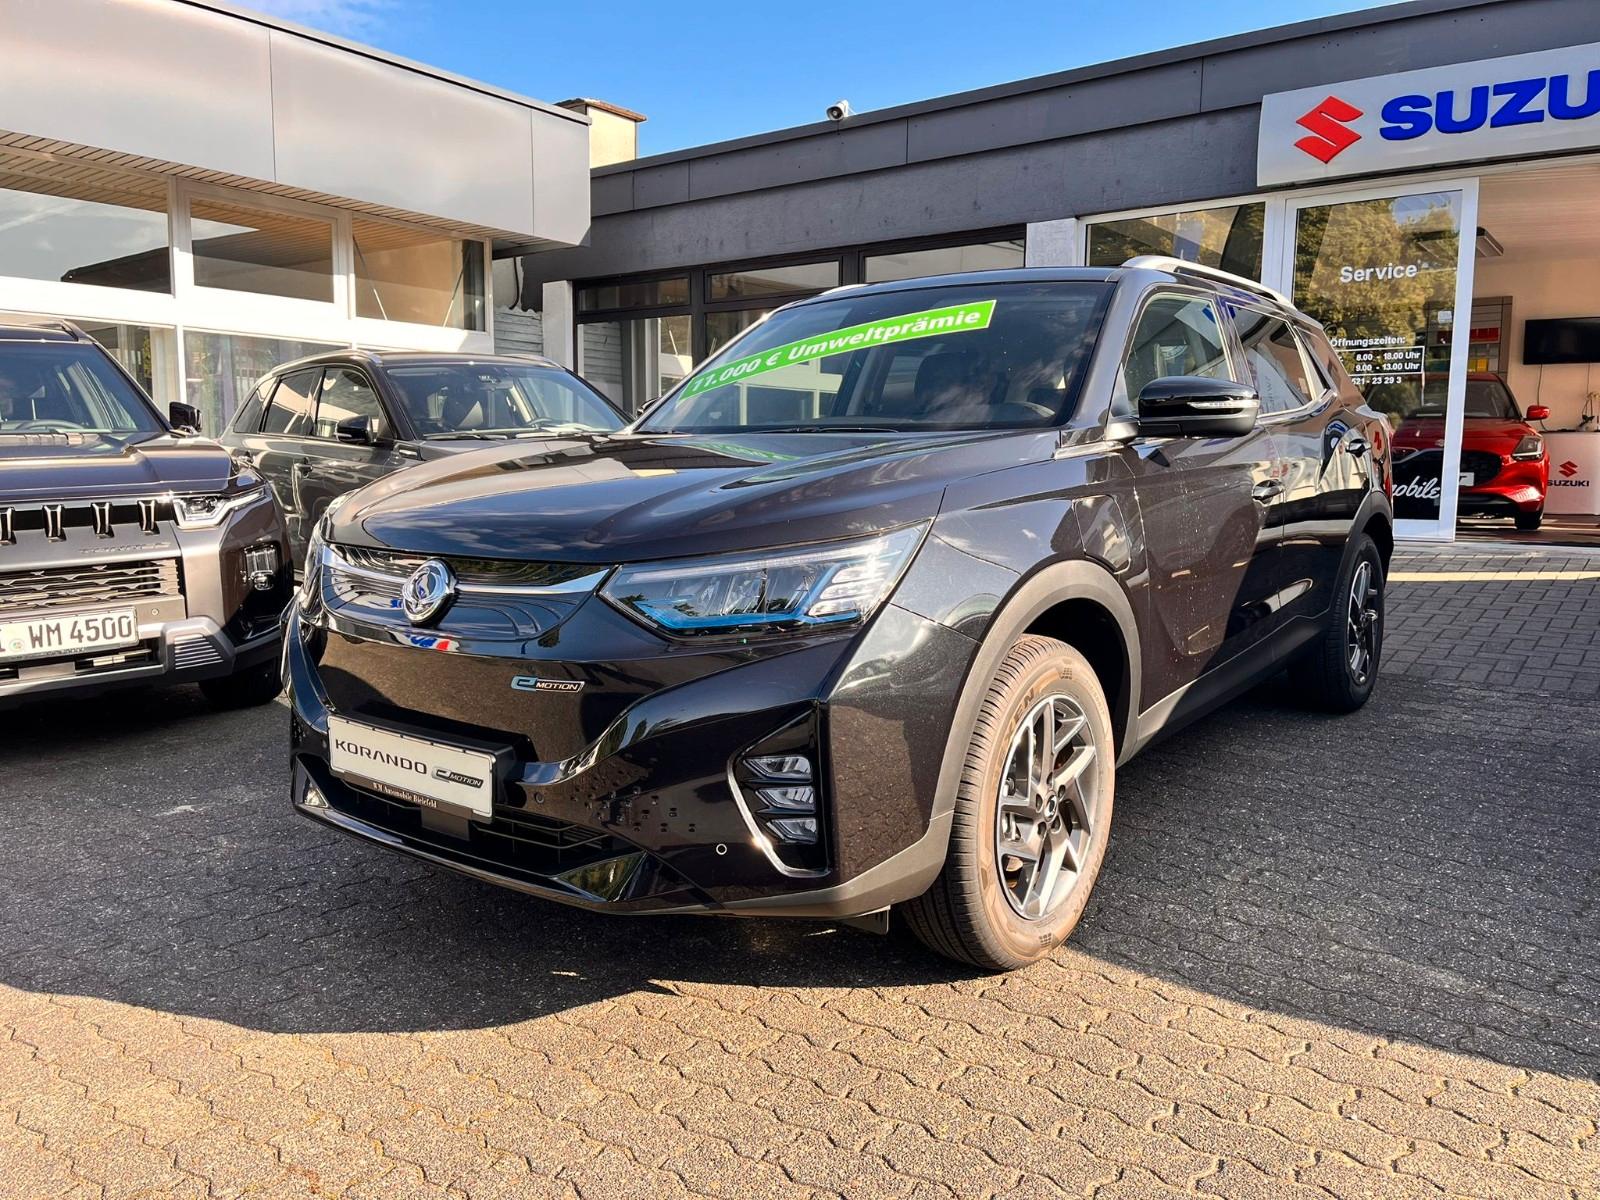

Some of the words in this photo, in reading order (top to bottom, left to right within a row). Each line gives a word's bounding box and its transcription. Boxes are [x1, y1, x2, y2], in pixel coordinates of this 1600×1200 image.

[1379, 69, 1600, 142] SUZU
[1340, 262, 1418, 283] Service
[765, 351, 782, 367] €
[788, 310, 981, 361] Umweltprämie
[1330, 336, 1406, 347] Öffnungszeiten:
[1356, 353, 1373, 361] 8.00
[1383, 352, 1404, 360] 18.00
[1405, 351, 1421, 359] Uhr
[1355, 364, 1373, 372] 9.00
[1382, 363, 1403, 371] 13.00
[1404, 362, 1420, 370] Uhr
[1371, 377, 1382, 385] 23
[1384, 377, 1394, 385] 29
[1547, 479, 1590, 487] SUZUKI
[28, 622, 63, 649] WM
[70, 615, 132, 643] 4500
[335, 738, 428, 775] KORANDO
